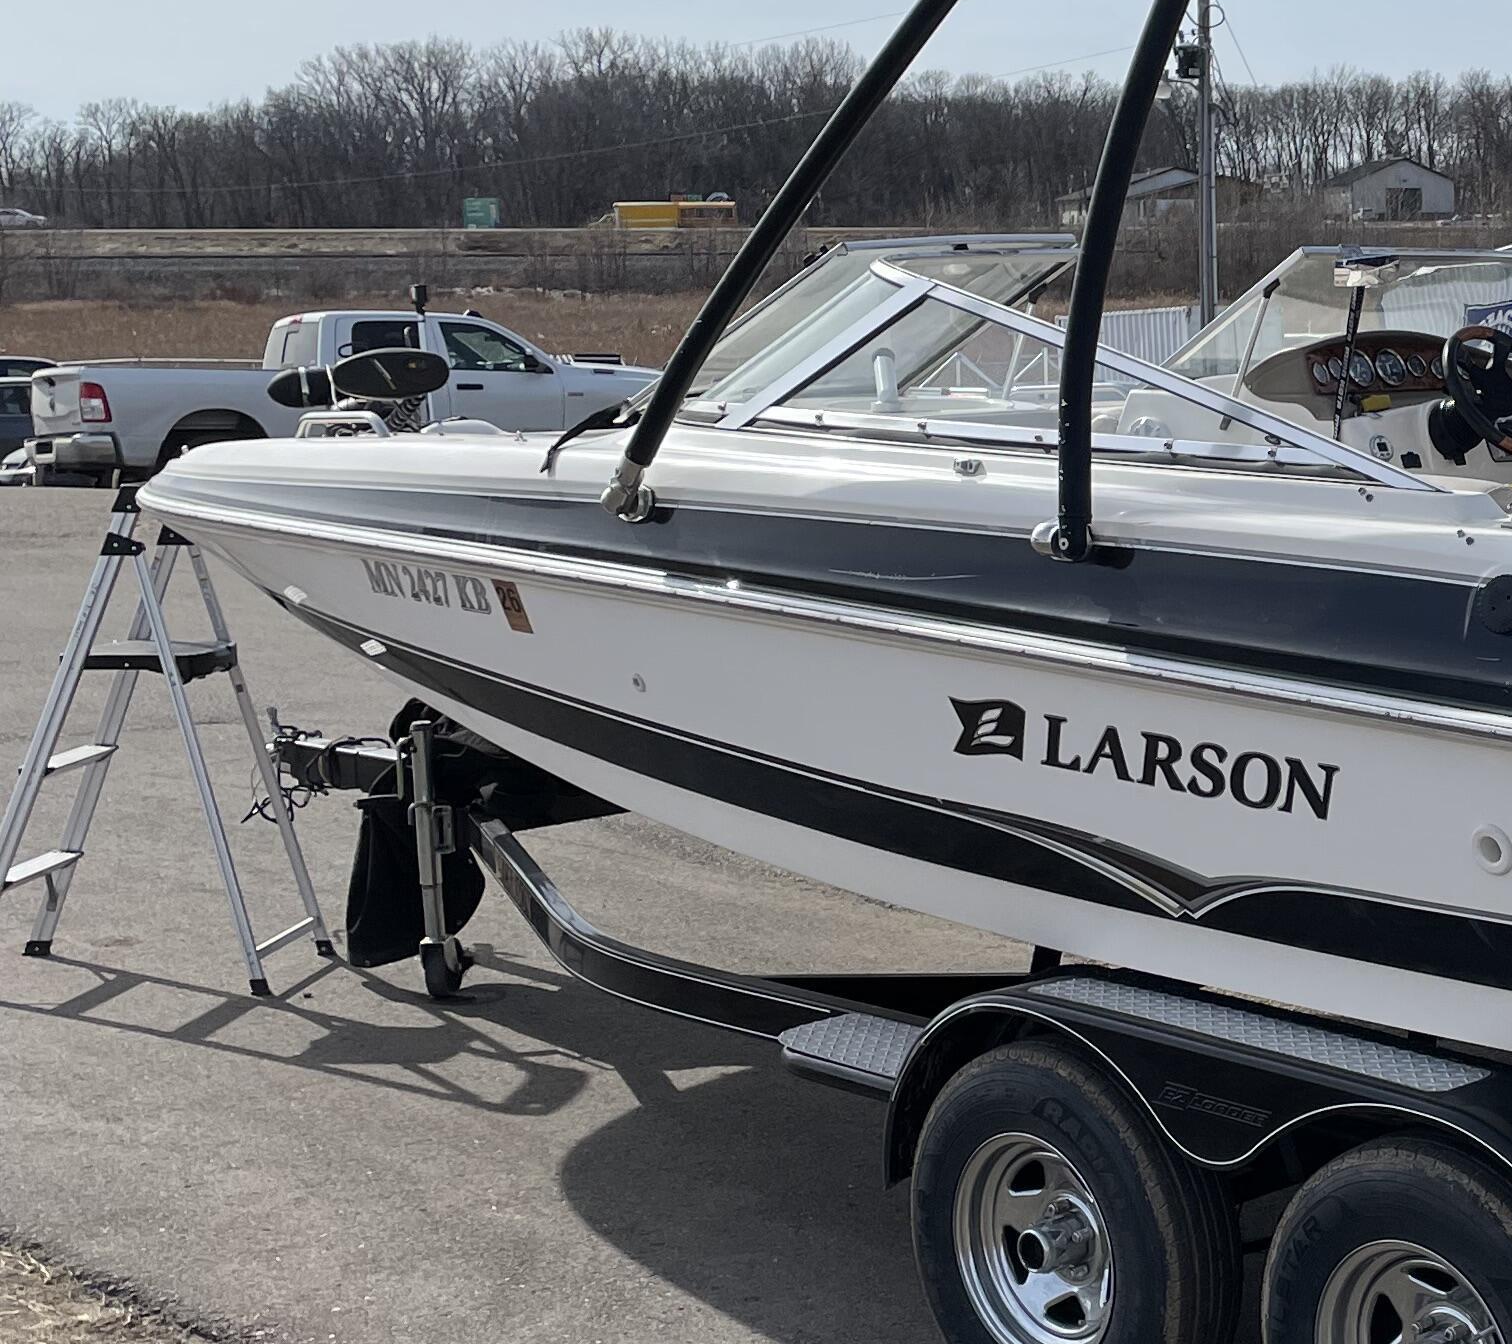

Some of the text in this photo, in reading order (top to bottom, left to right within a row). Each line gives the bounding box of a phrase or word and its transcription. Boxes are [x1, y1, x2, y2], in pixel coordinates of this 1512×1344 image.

[360, 559, 406, 599] MN
[402, 565, 450, 608] 2427
[496, 586, 522, 613] 26
[1040, 713, 1341, 821] LARSON
